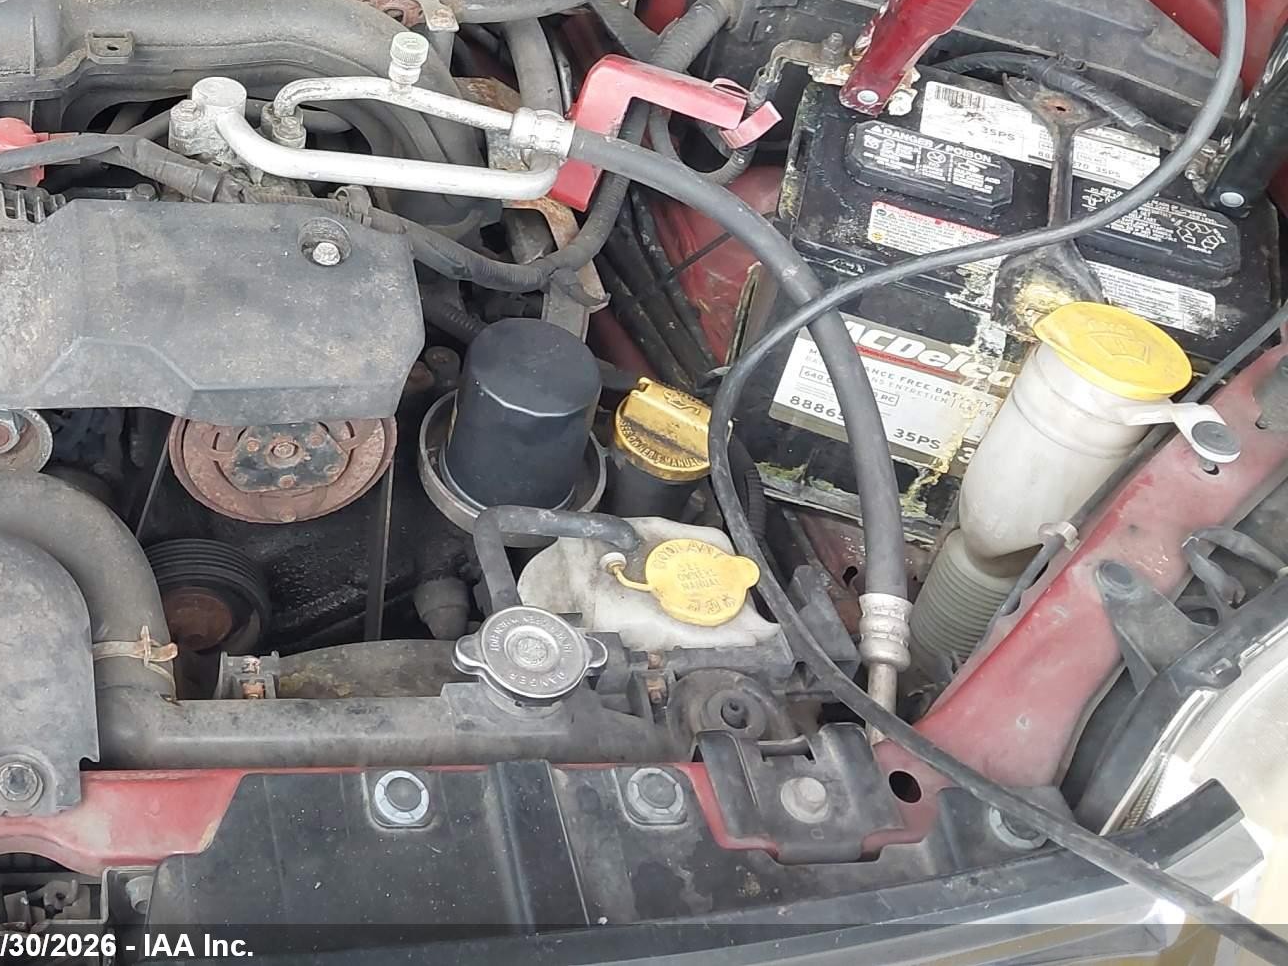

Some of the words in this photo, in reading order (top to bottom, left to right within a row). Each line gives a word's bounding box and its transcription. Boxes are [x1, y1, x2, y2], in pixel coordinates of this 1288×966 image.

[883, 126, 934, 149] DANGER
[945, 143, 992, 163] POISON
[893, 428, 941, 450] 35PS
